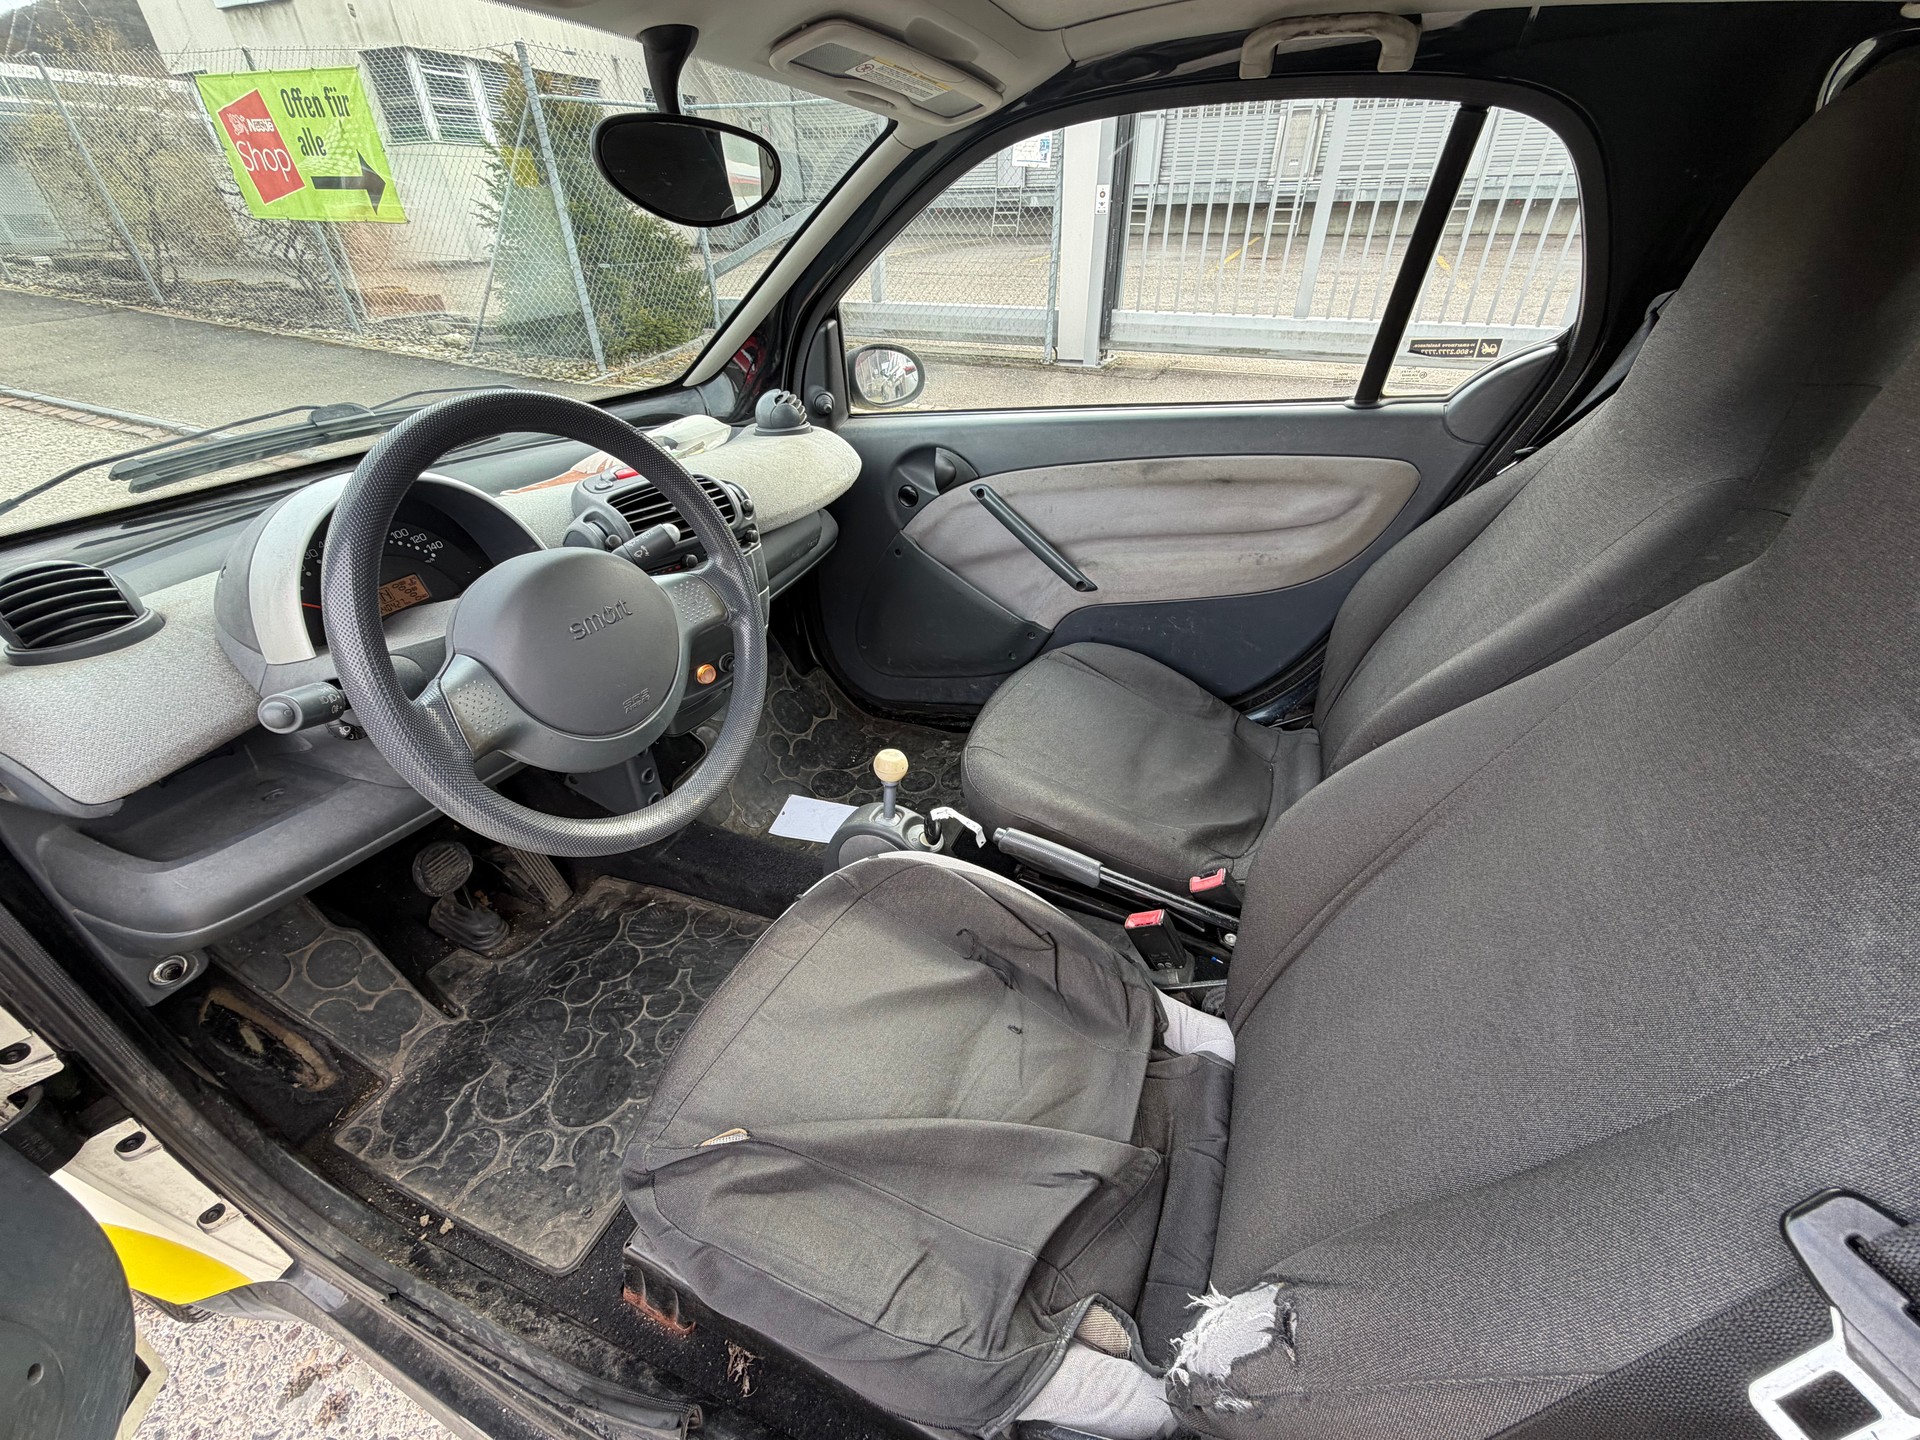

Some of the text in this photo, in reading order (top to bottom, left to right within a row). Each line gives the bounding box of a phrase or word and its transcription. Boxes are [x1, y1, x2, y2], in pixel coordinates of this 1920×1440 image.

[280, 86, 350, 118] Offen für
[297, 127, 327, 156] alle
[236, 140, 292, 183] Shop
[390, 528, 409, 540] 100
[409, 533, 428, 544] 120
[425, 540, 444, 552] 140
[569, 598, 633, 641] smart
